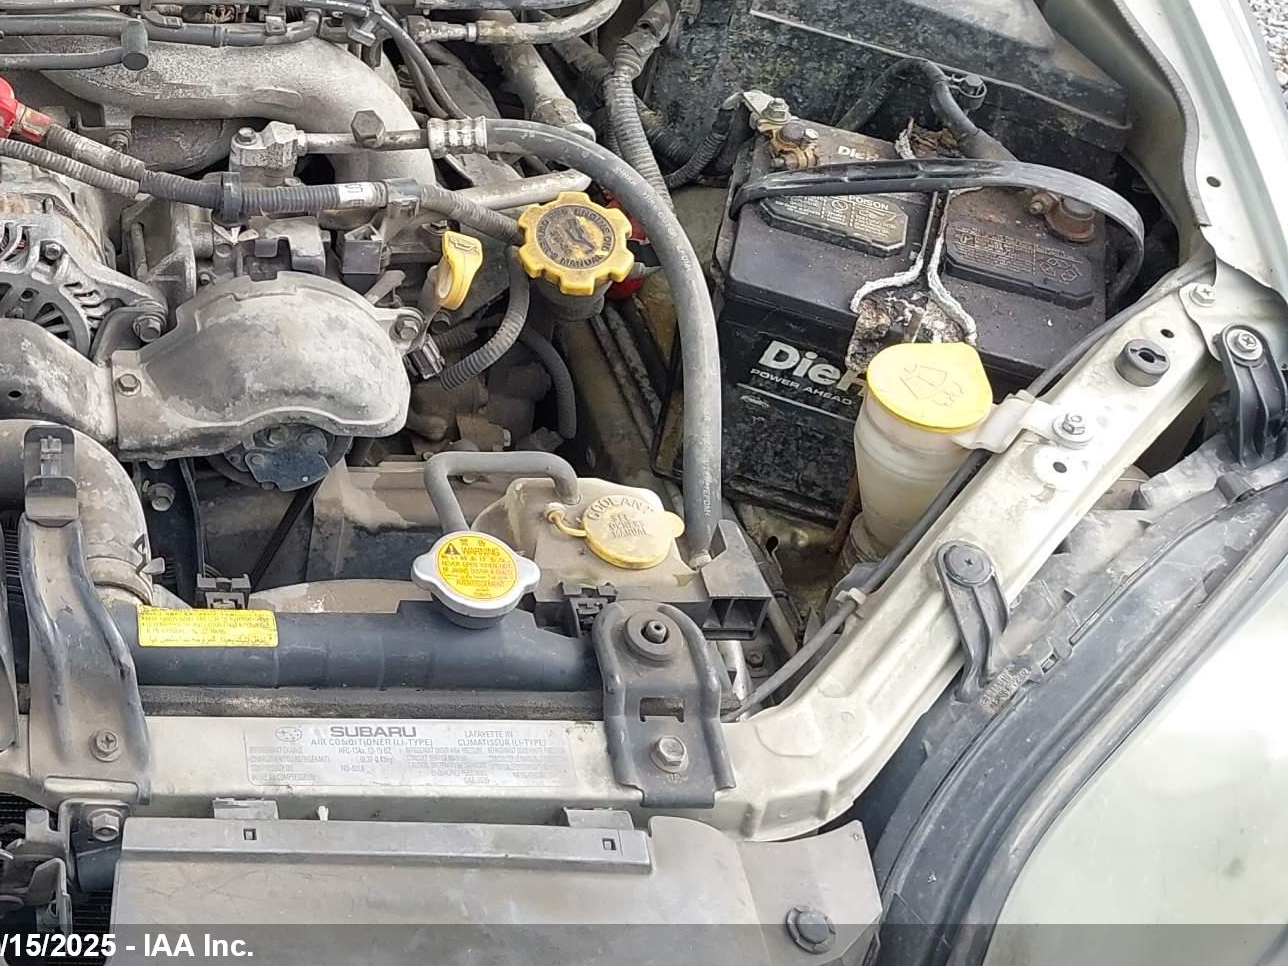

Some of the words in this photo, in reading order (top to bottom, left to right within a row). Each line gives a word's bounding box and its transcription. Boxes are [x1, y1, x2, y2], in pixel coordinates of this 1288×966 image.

[848, 194, 889, 211] POISON
[750, 368, 800, 389] POWER
[803, 386, 853, 405] AHEAD
[461, 547, 500, 556] WARNING
[329, 726, 417, 738] SUBARU
[464, 730, 505, 739] LAFAYETTE
[311, 738, 328, 747] AIR
[328, 738, 392, 747] CONDITIONER
